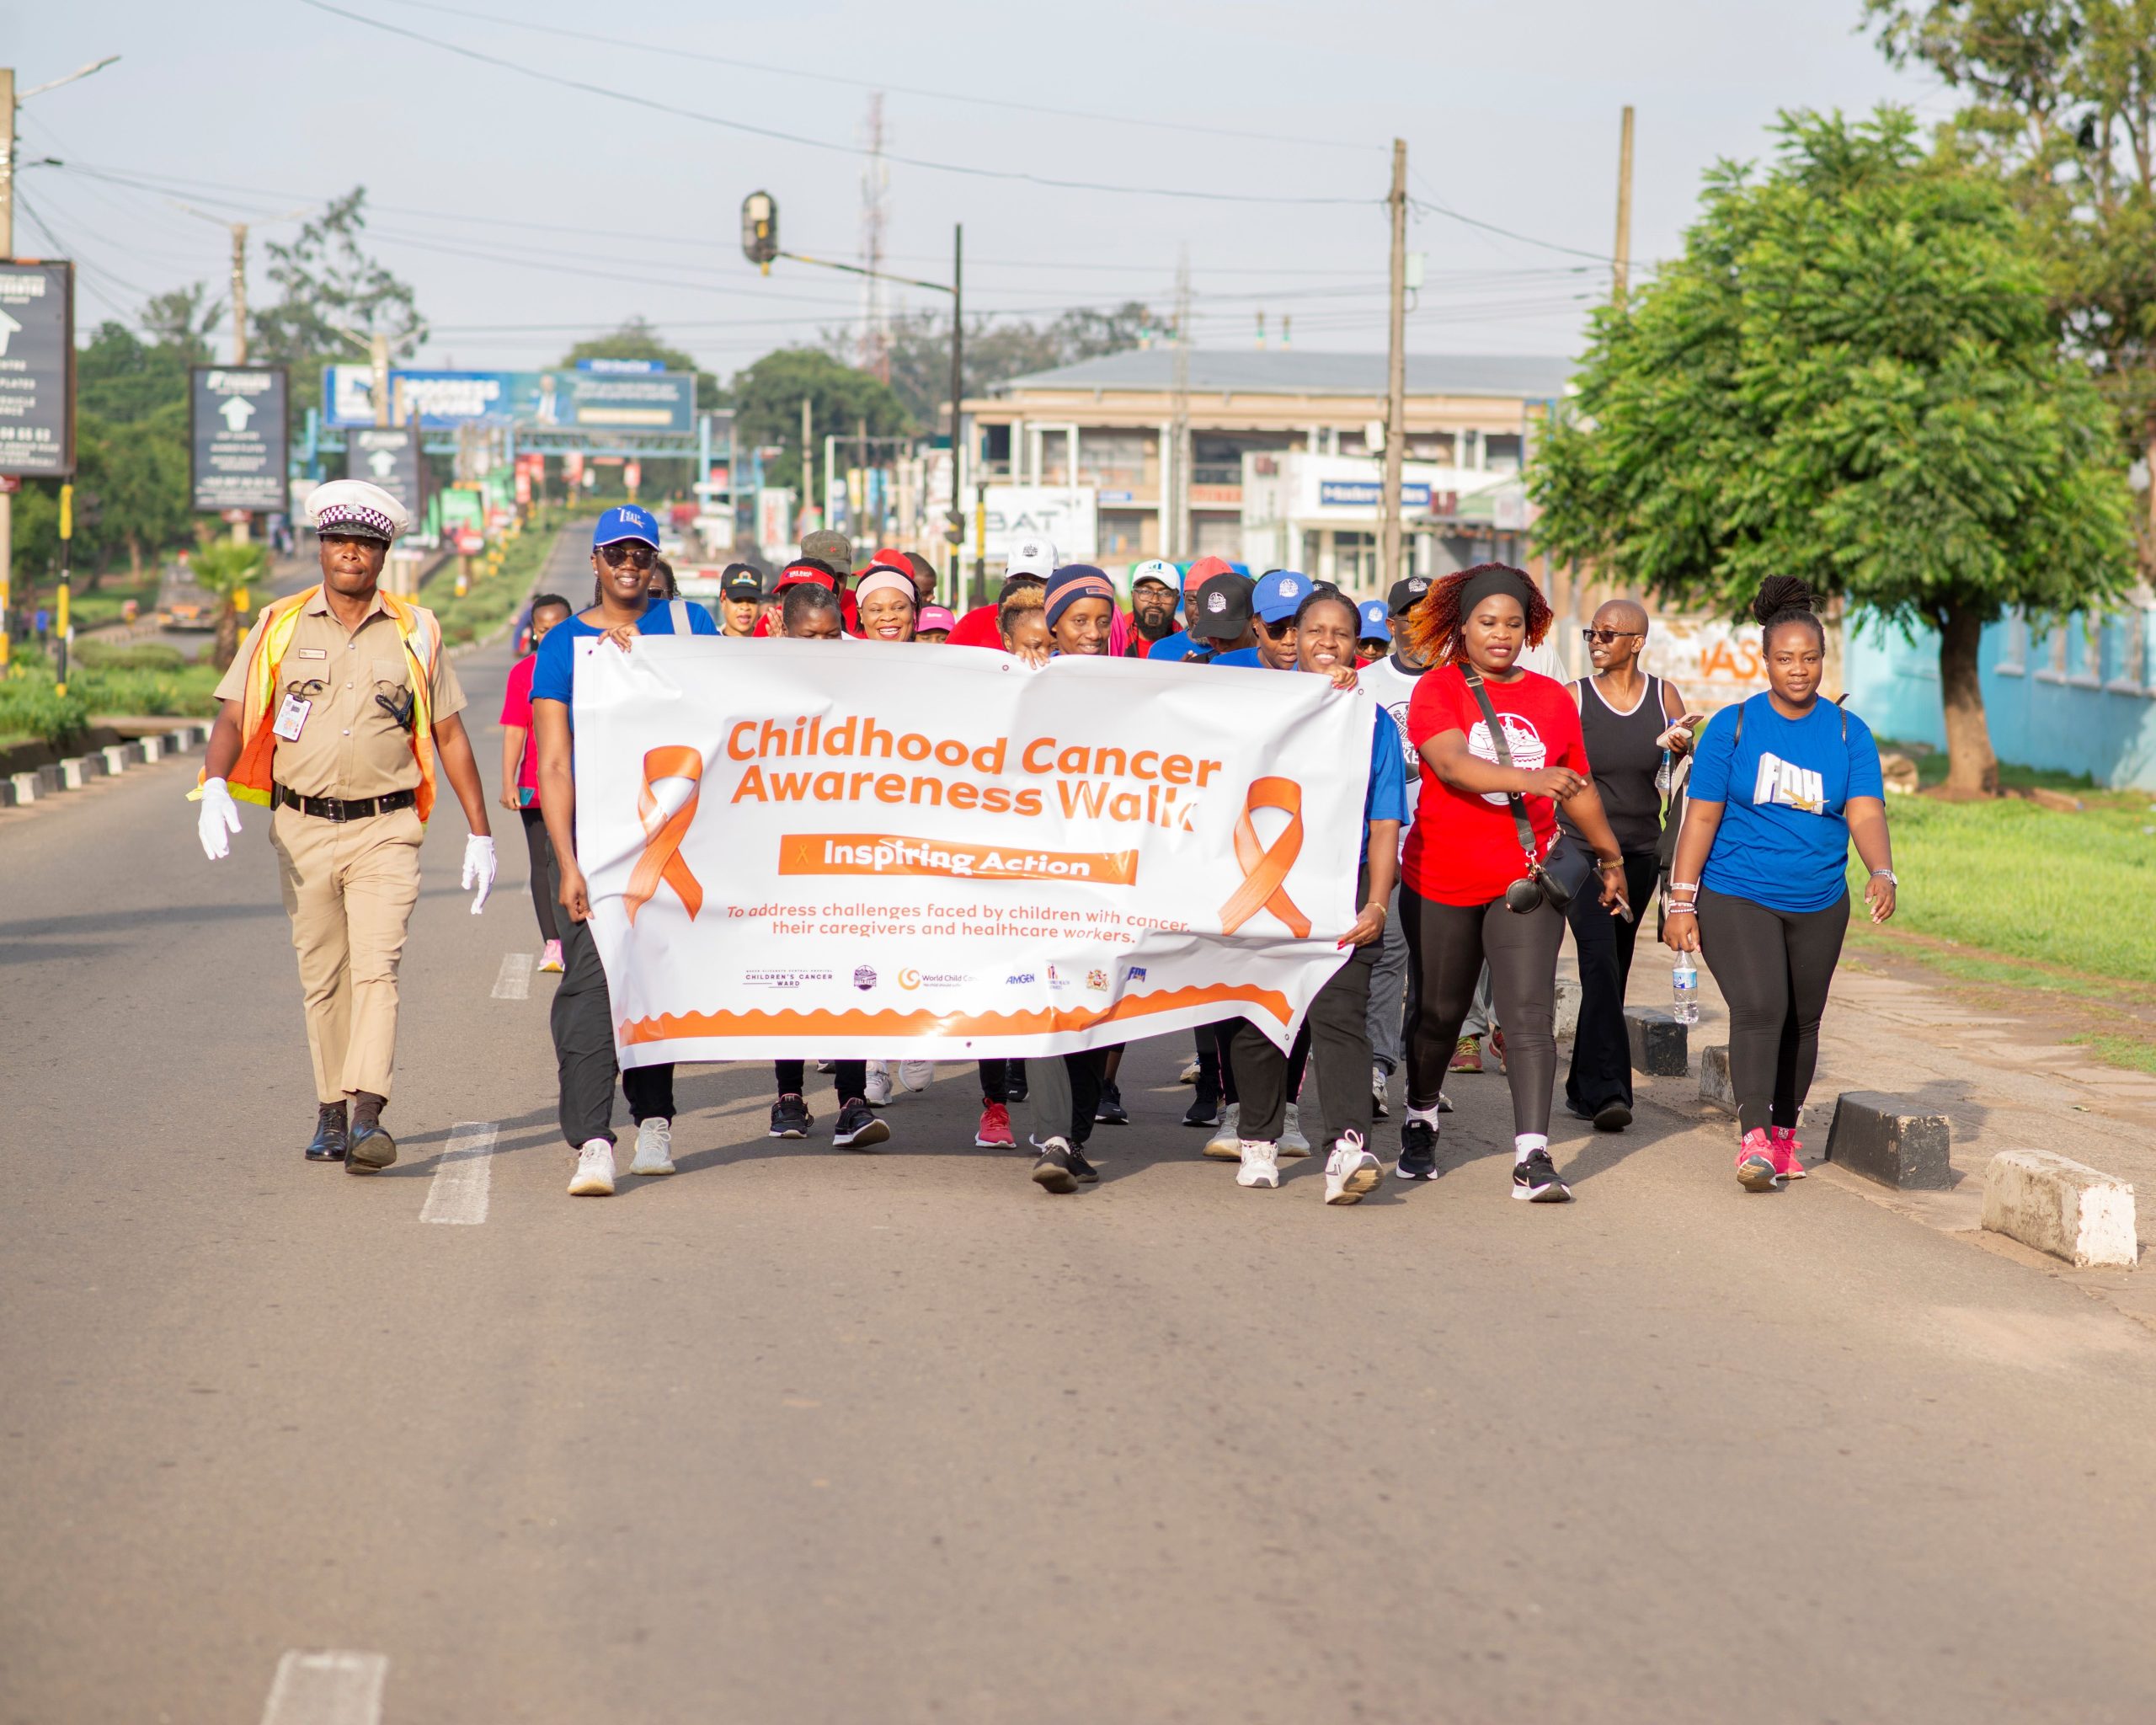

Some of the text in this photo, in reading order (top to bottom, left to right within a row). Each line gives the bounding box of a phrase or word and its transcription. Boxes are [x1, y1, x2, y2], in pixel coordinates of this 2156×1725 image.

[727, 715, 1222, 788] Childhood Cancer
[730, 765, 1199, 832] Awareness Walk
[1753, 751, 1824, 815] FDH
[824, 840, 1091, 877] Inspiring Action
[728, 905, 744, 918] To
[749, 903, 816, 918] address
[822, 903, 921, 920] challenges
[928, 904, 977, 918] faced
[983, 905, 1003, 921] by
[1009, 906, 1081, 921] children
[1086, 911, 1121, 925] with
[773, 921, 1136, 943] their caregivers and healthcare workers.
[1006, 974, 1035, 985] AMGEN
